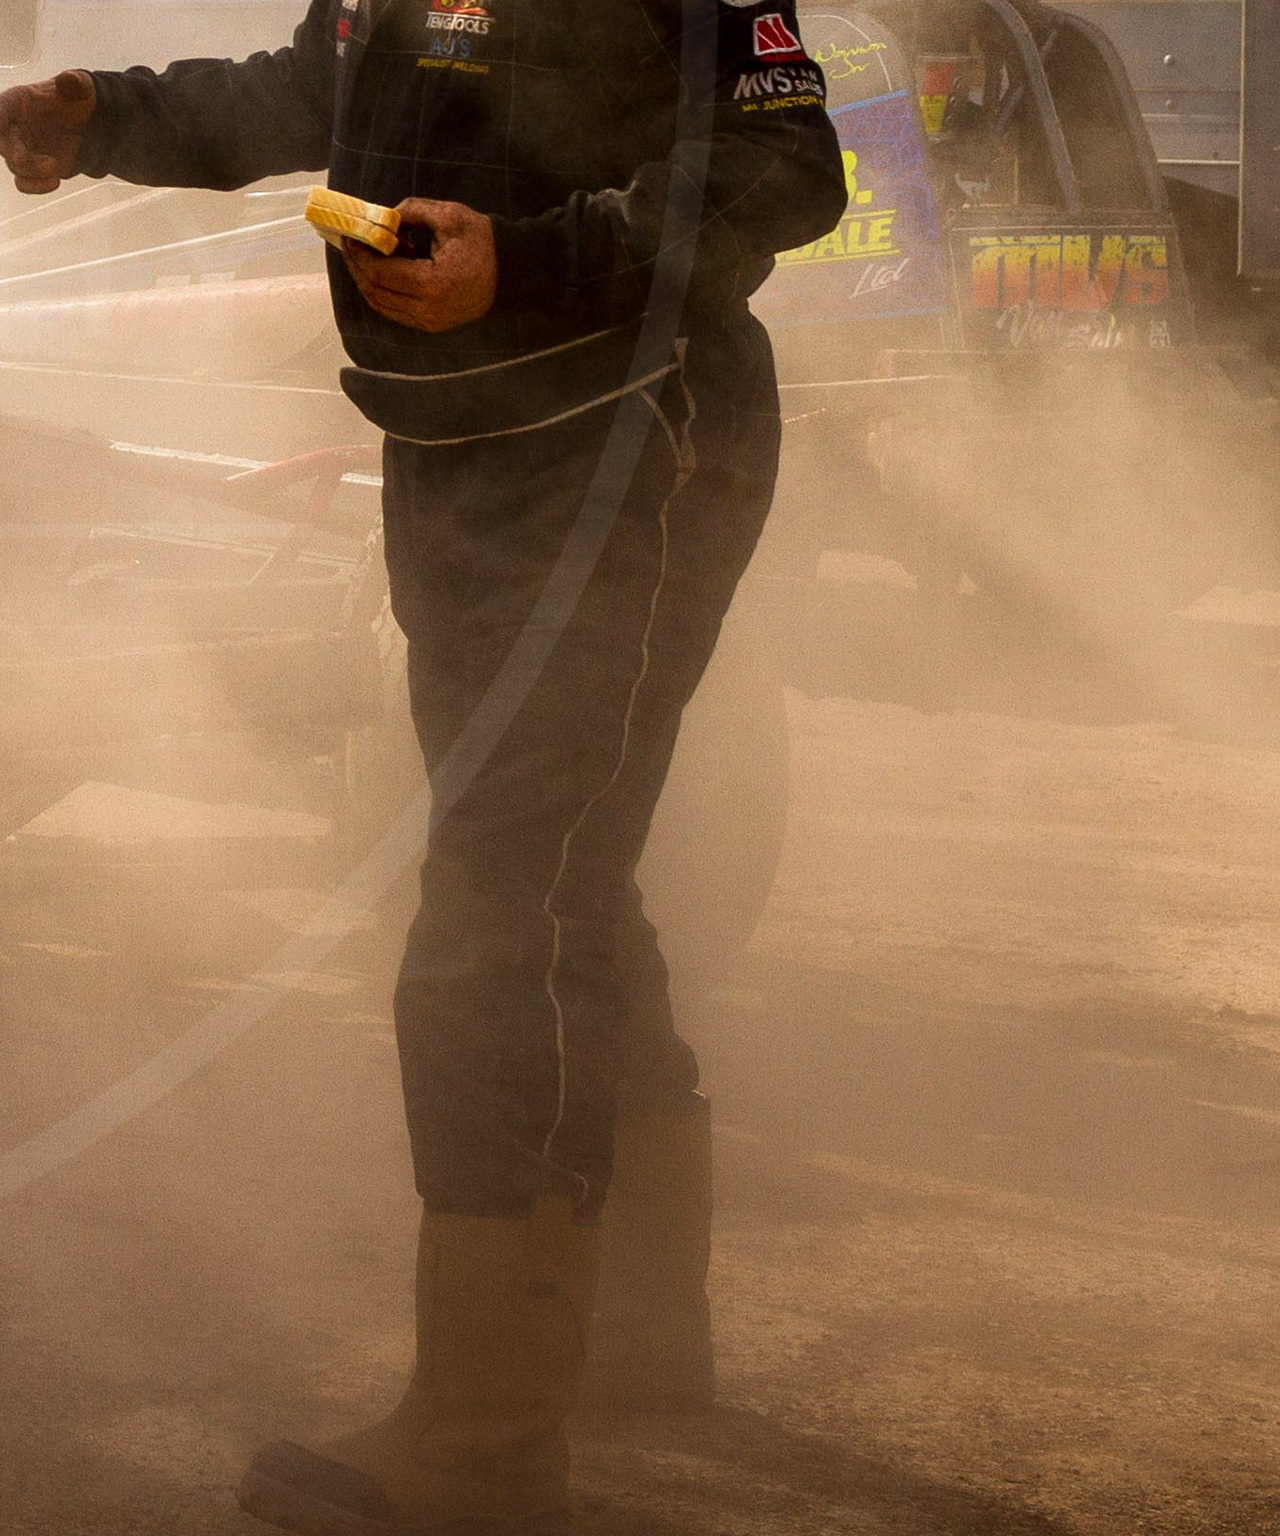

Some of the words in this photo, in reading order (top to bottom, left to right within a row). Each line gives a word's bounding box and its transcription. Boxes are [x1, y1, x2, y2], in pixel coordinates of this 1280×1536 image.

[733, 67, 793, 100] MVS
[762, 94, 818, 111] JUNCTION
[849, 257, 911, 299] Ltd
